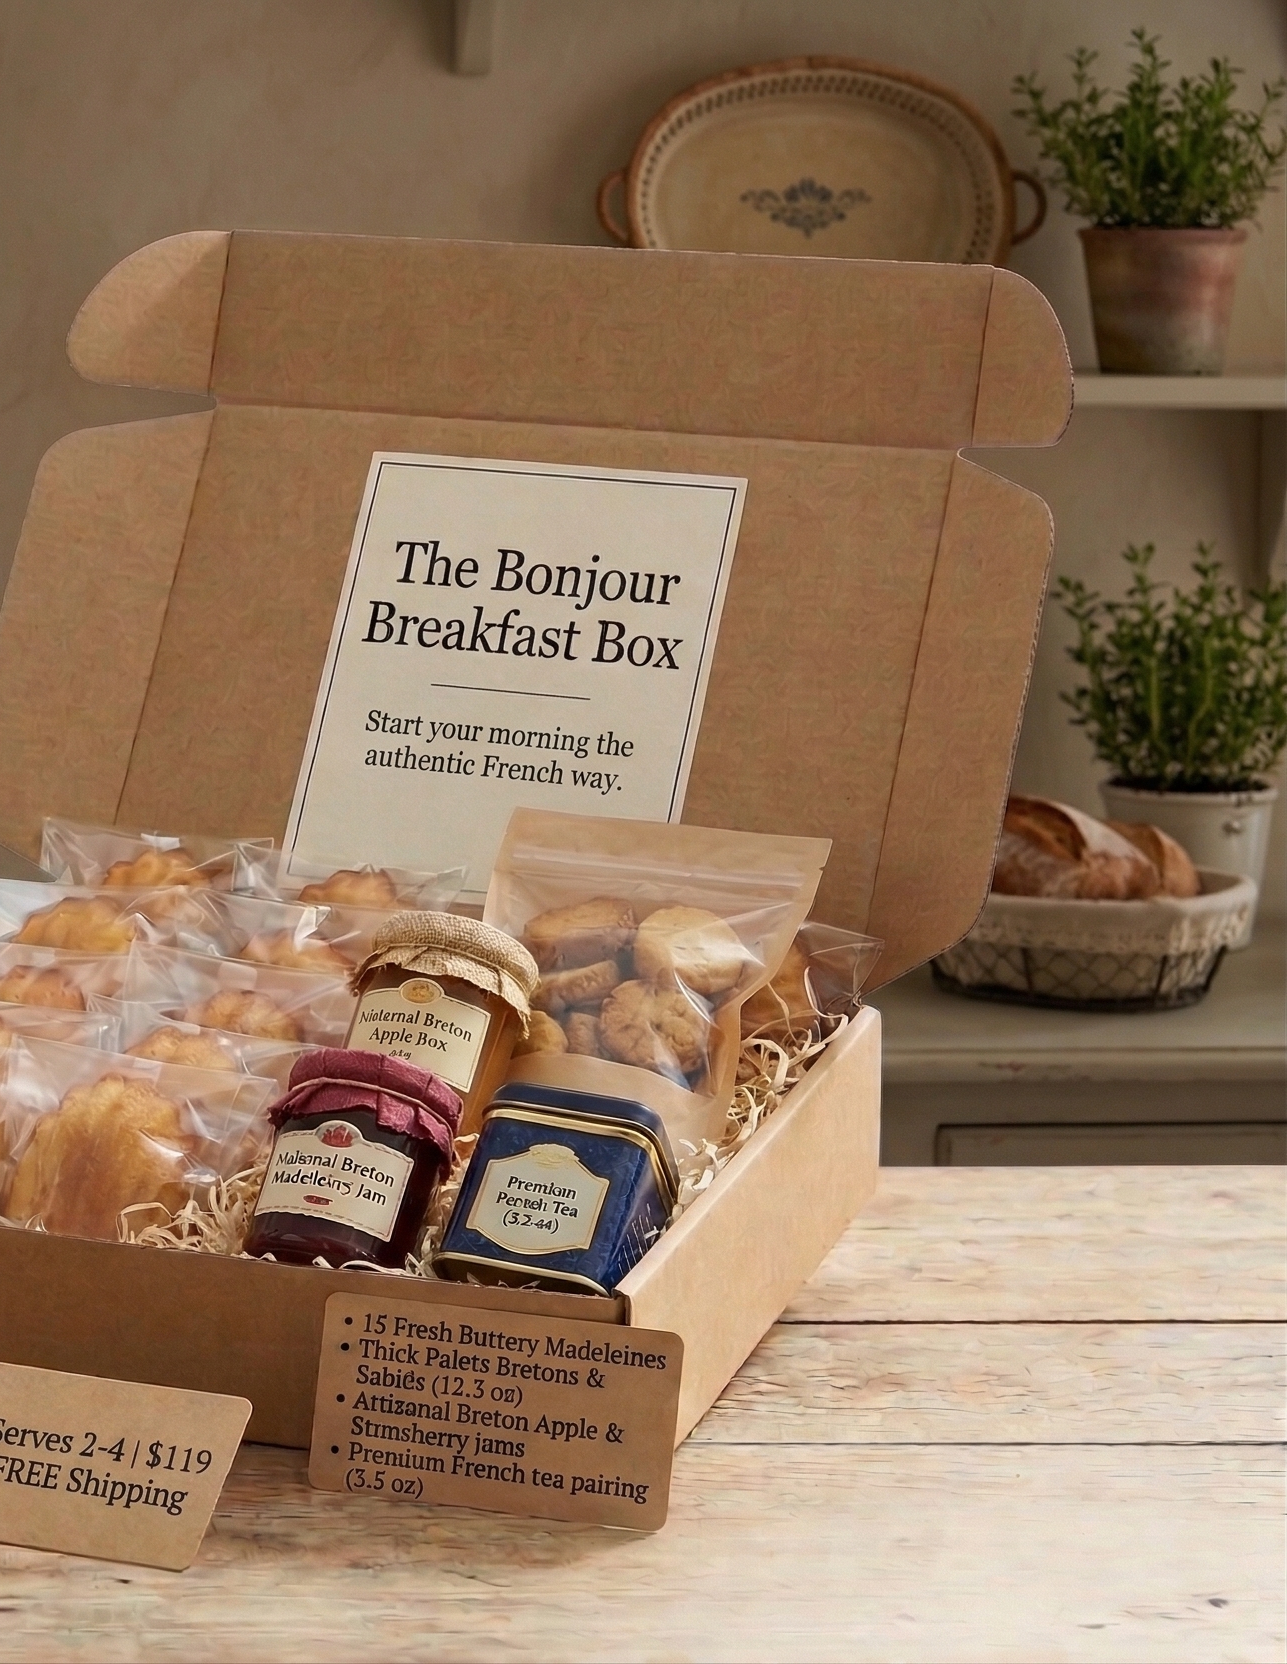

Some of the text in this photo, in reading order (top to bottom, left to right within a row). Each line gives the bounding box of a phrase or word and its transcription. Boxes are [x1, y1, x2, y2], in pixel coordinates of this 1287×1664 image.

[395, 540, 682, 611] The Bonjour
[362, 600, 684, 670] Breakfast Box
[365, 709, 635, 759] Start your morning the
[364, 746, 623, 795] authentic French way.
[369, 1027, 448, 1052] Apple Box
[423, 1012, 472, 1042] Breton
[341, 1157, 395, 1188] Breton
[356, 1184, 387, 1206] Jam
[553, 1201, 578, 1218] Tea
[362, 1312, 667, 1371] 15 Fresh Buttery Madeleines
[358, 1338, 606, 1389] Thick Palets Bretons &
[431, 1374, 486, 1399] (12.3
[456, 1404, 529, 1433] Breton
[533, 1418, 598, 1442] Apple
[605, 1423, 625, 1444] &
[79, 1432, 126, 1463] 2-4
[145, 1440, 213, 1475] $119
[474, 1435, 526, 1458] jams
[65, 1467, 188, 1517] Shipping
[345, 1468, 424, 1499] (3.5 oz)
[451, 1456, 526, 1484] French
[531, 1469, 565, 1490] tea
[570, 1474, 650, 1505] pairing
